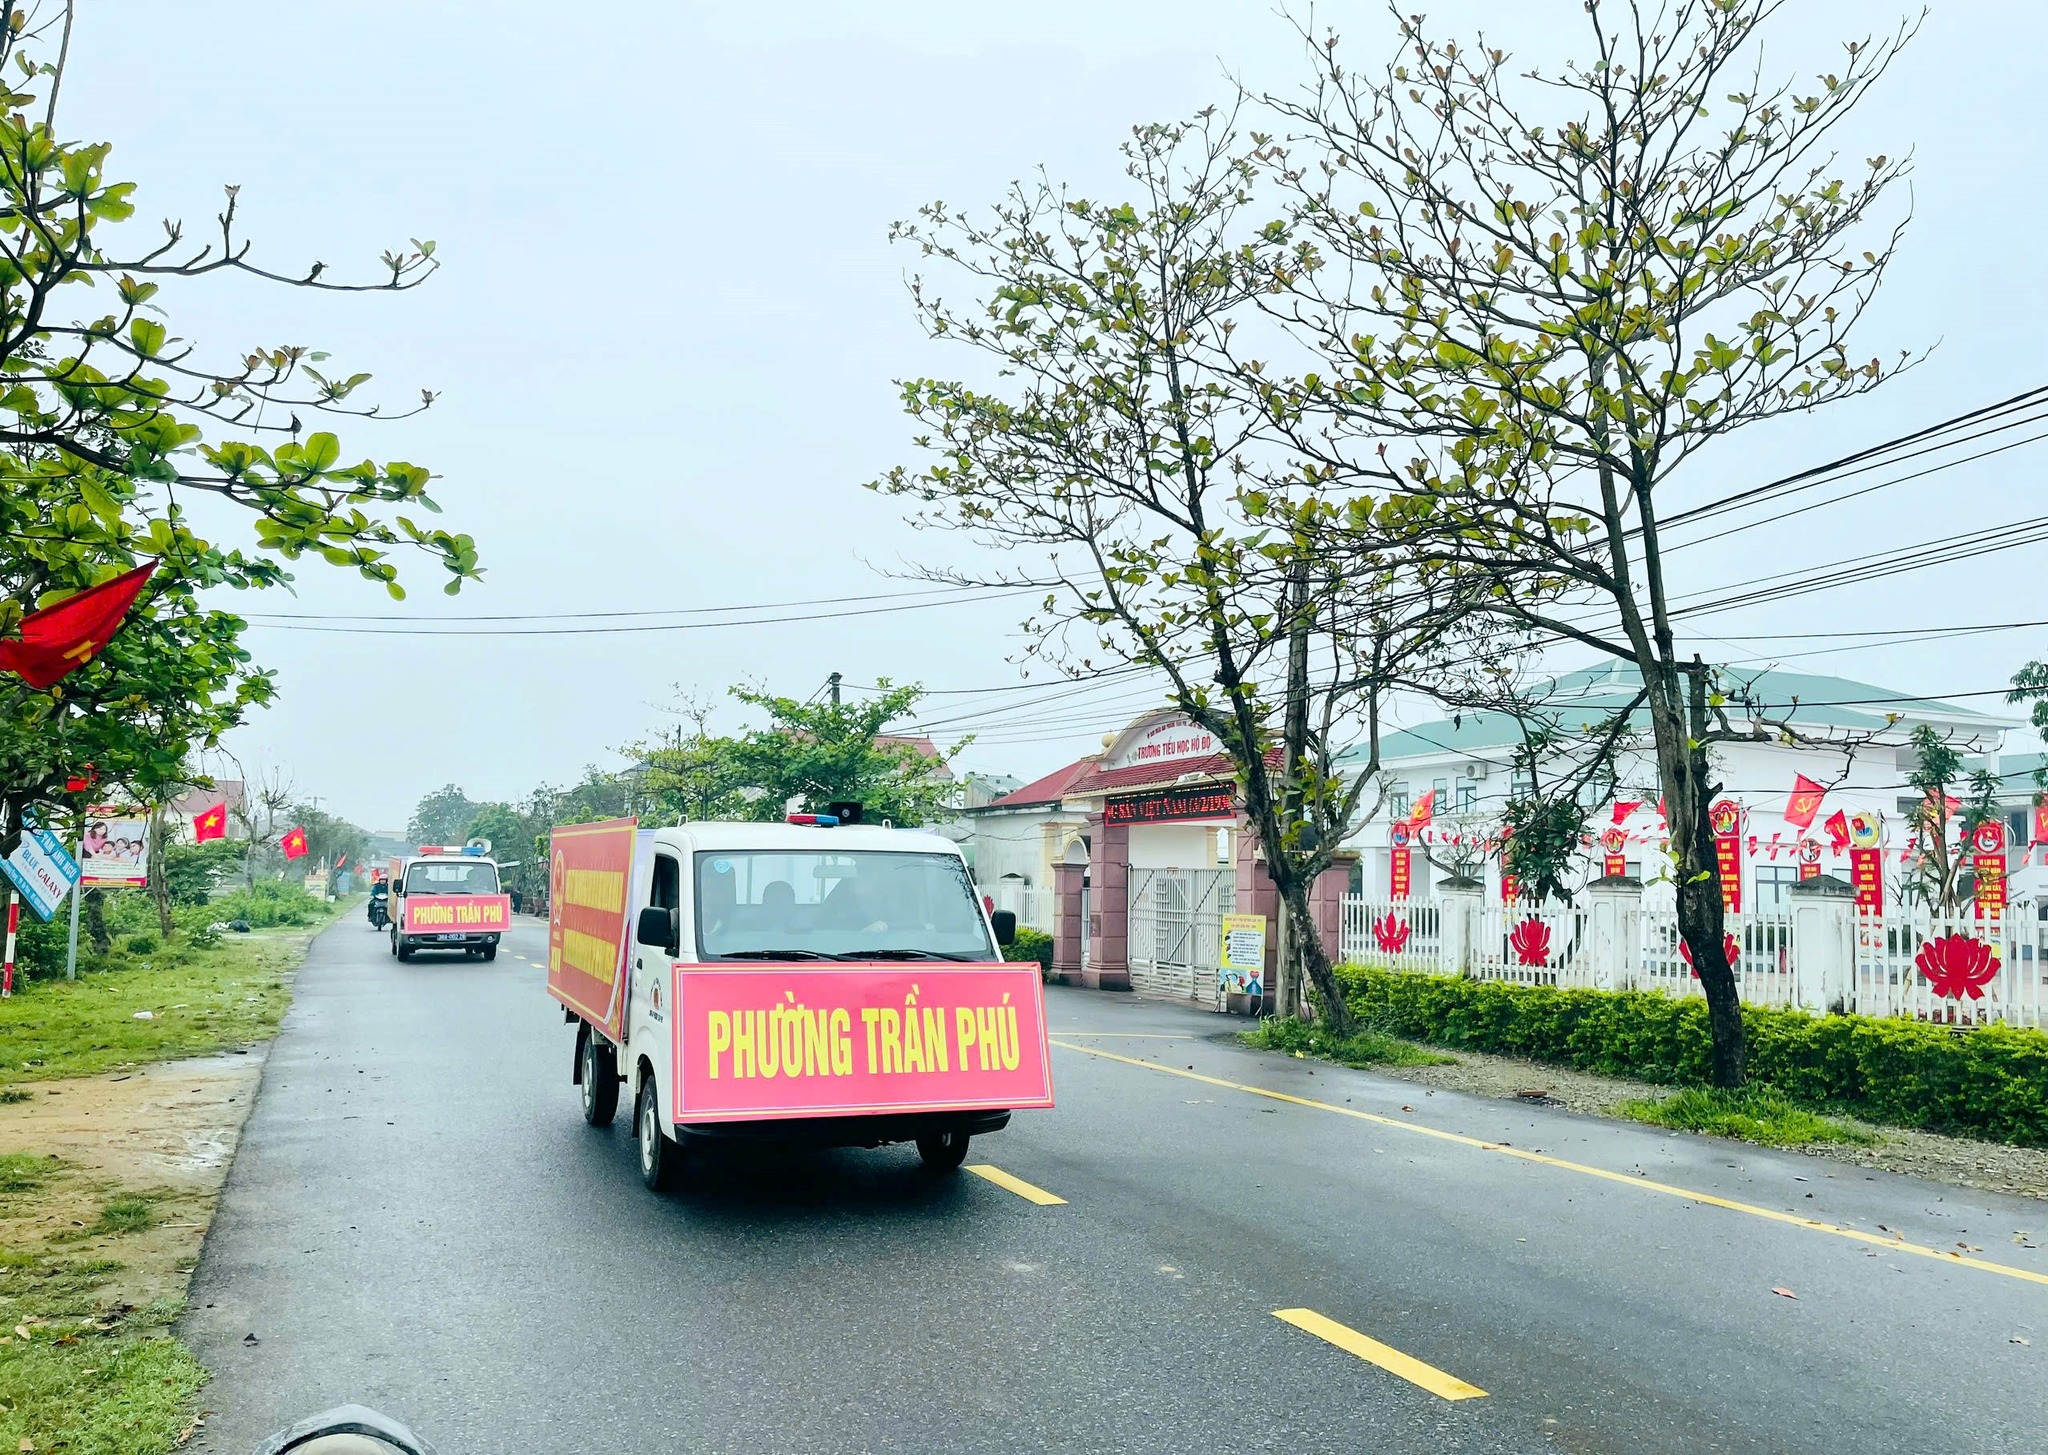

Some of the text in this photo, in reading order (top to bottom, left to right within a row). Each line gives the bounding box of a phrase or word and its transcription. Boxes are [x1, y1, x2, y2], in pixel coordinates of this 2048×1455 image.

[1138, 733, 1211, 759] TRƯỜNG TIỂU HỌC HỘ ĐỘ
[22, 849, 40, 870] BLUE
[38, 868, 62, 898] GALAXY
[414, 900, 502, 924] PHƯỜNG TRẦN PHÚ
[708, 984, 1020, 1080] PHƯỜNG TRẦN PHÚ
